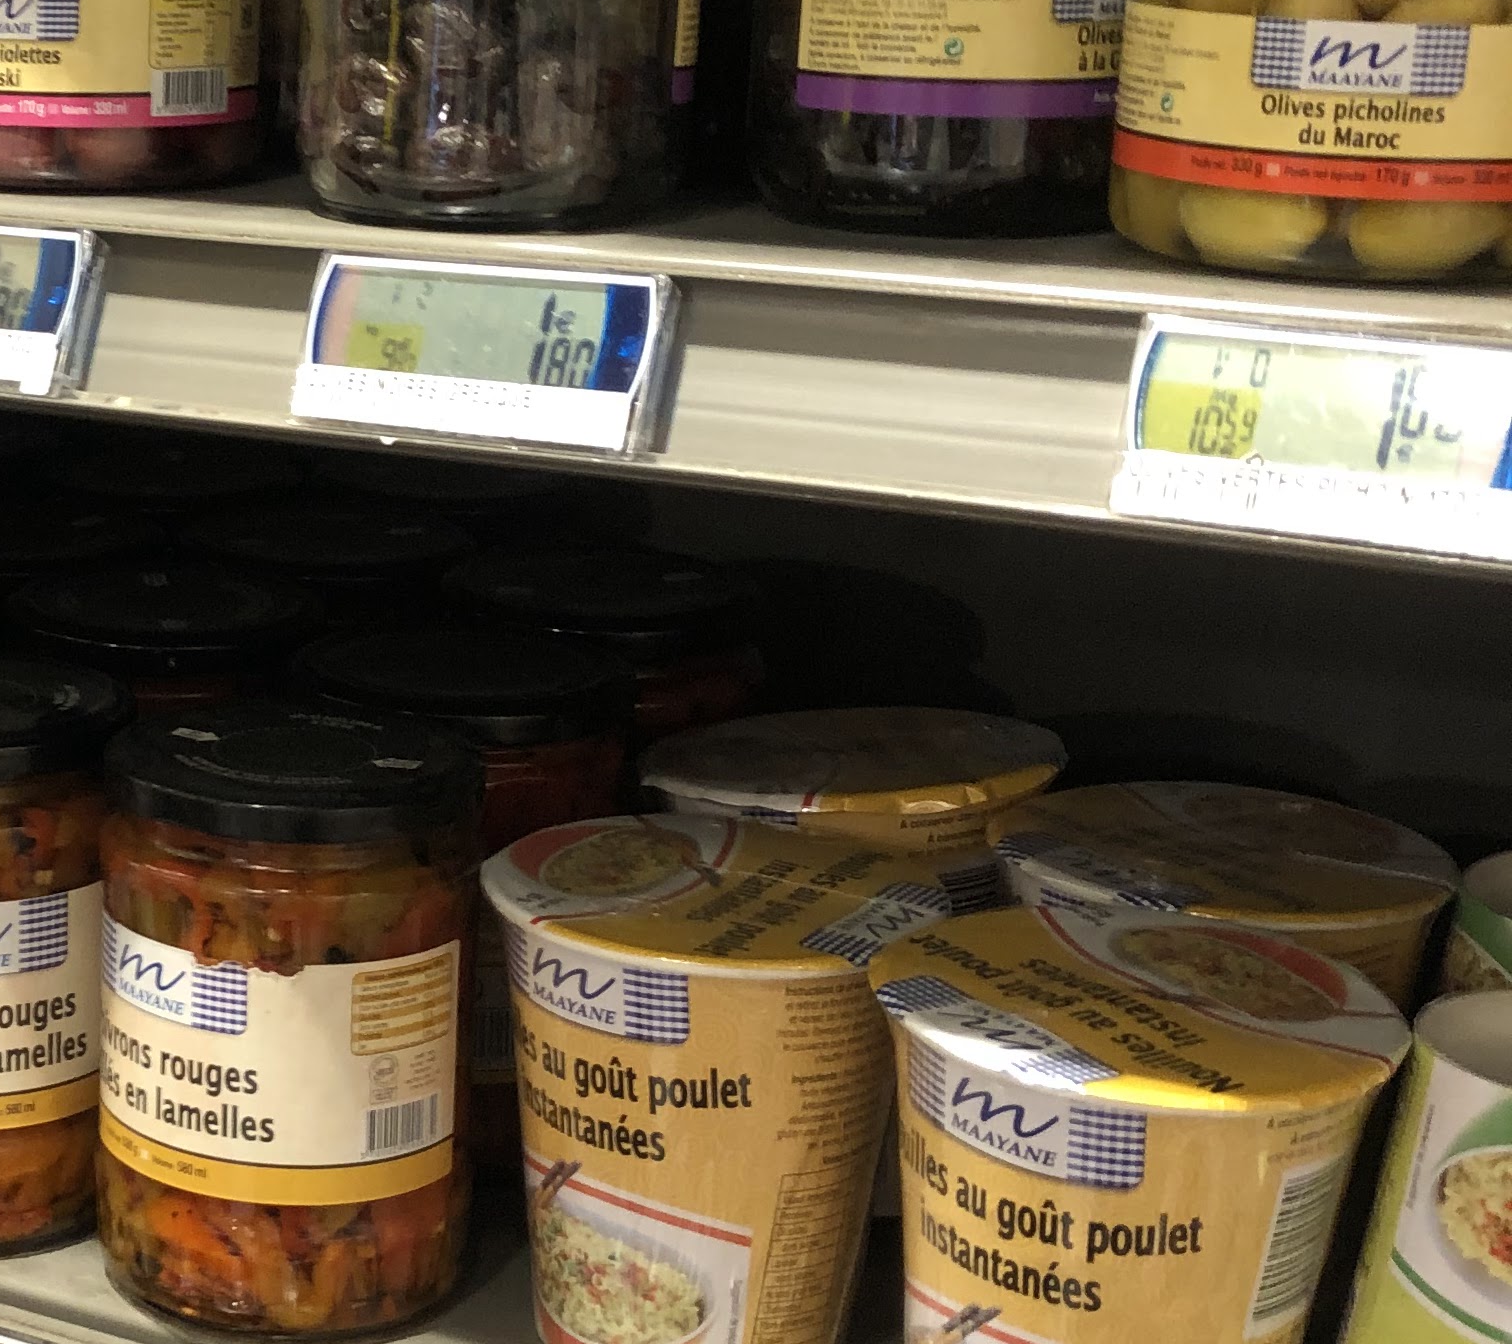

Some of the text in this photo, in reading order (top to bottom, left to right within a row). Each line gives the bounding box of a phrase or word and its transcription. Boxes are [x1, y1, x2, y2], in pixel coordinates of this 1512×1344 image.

[1261, 94, 1446, 123] Olives picholines
[1299, 126, 1400, 150] du Maroc
[118, 980, 185, 1017] MAAYANE
[533, 980, 616, 1026] MAAYANE
[159, 1053, 258, 1097] rouges
[542, 1040, 751, 1114] au goût poulet
[127, 1076, 275, 1145] en lamelles
[952, 1113, 1058, 1168] MAAYANE
[957, 1174, 1202, 1264] au goût poulet
[920, 1199, 1103, 1314] instantanées
